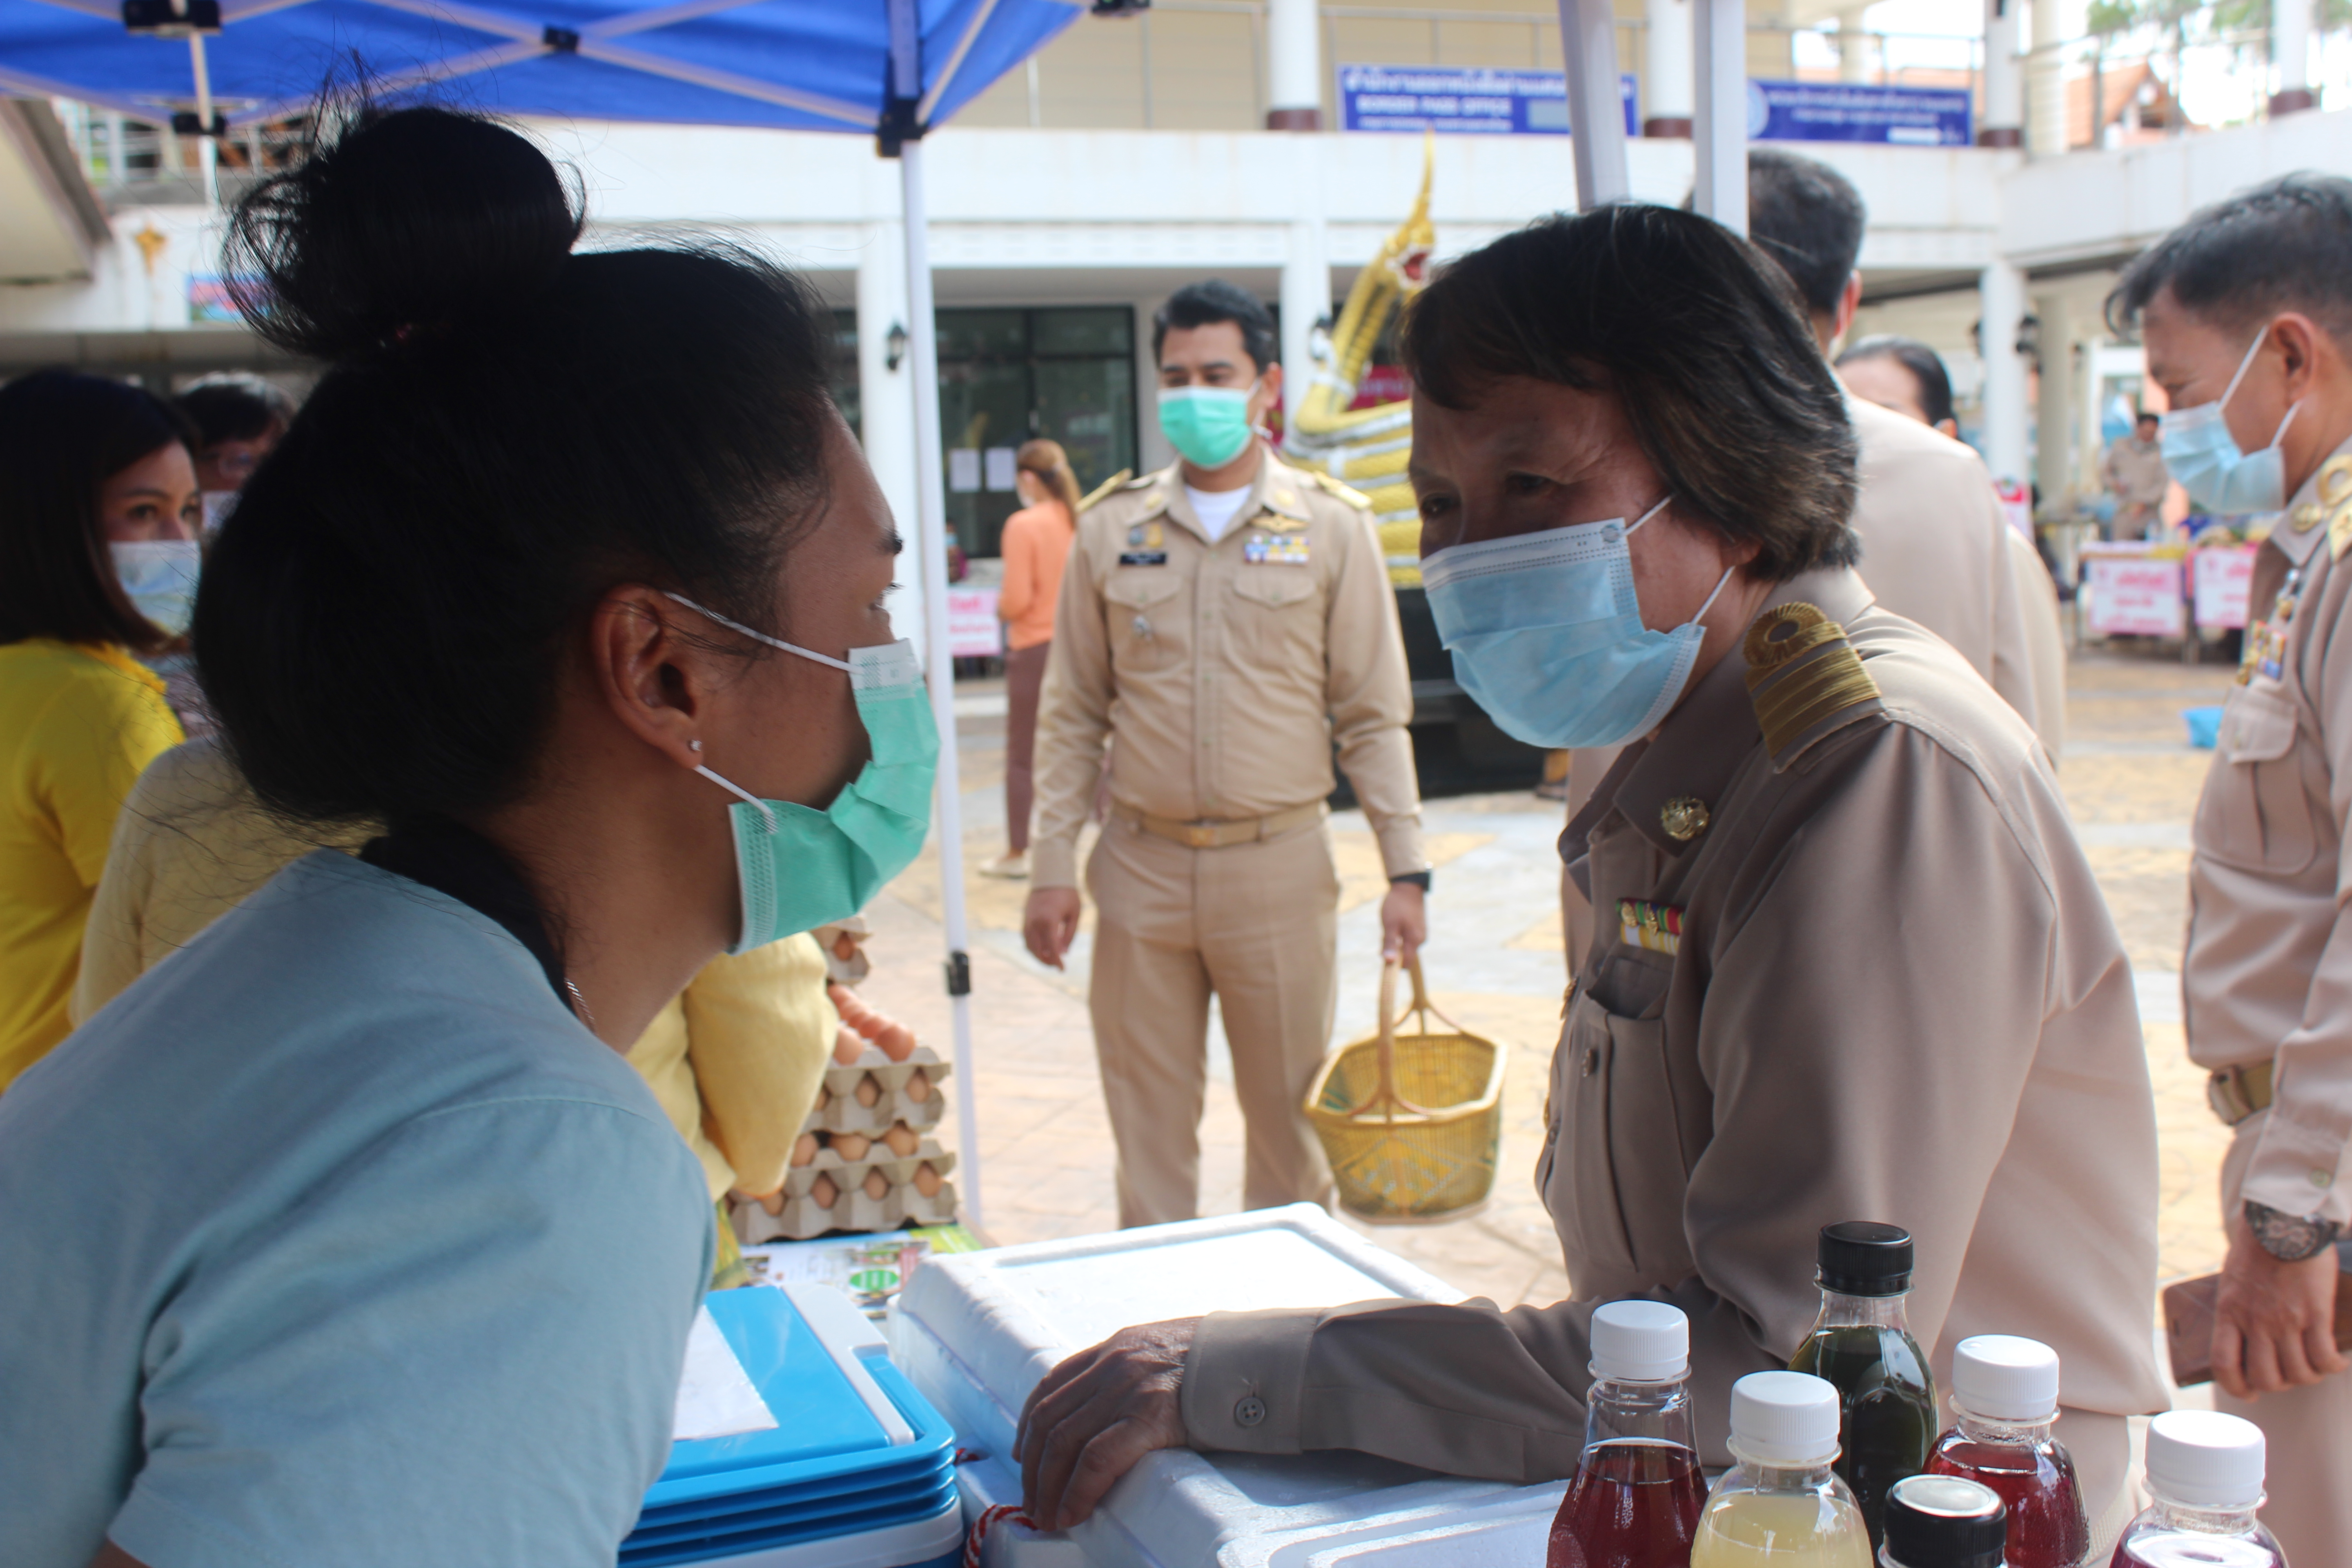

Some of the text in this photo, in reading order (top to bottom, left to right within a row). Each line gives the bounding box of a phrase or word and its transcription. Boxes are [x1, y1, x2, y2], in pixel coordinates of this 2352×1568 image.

[1357, 94, 1512, 115] BORDER PASS OFFICE
